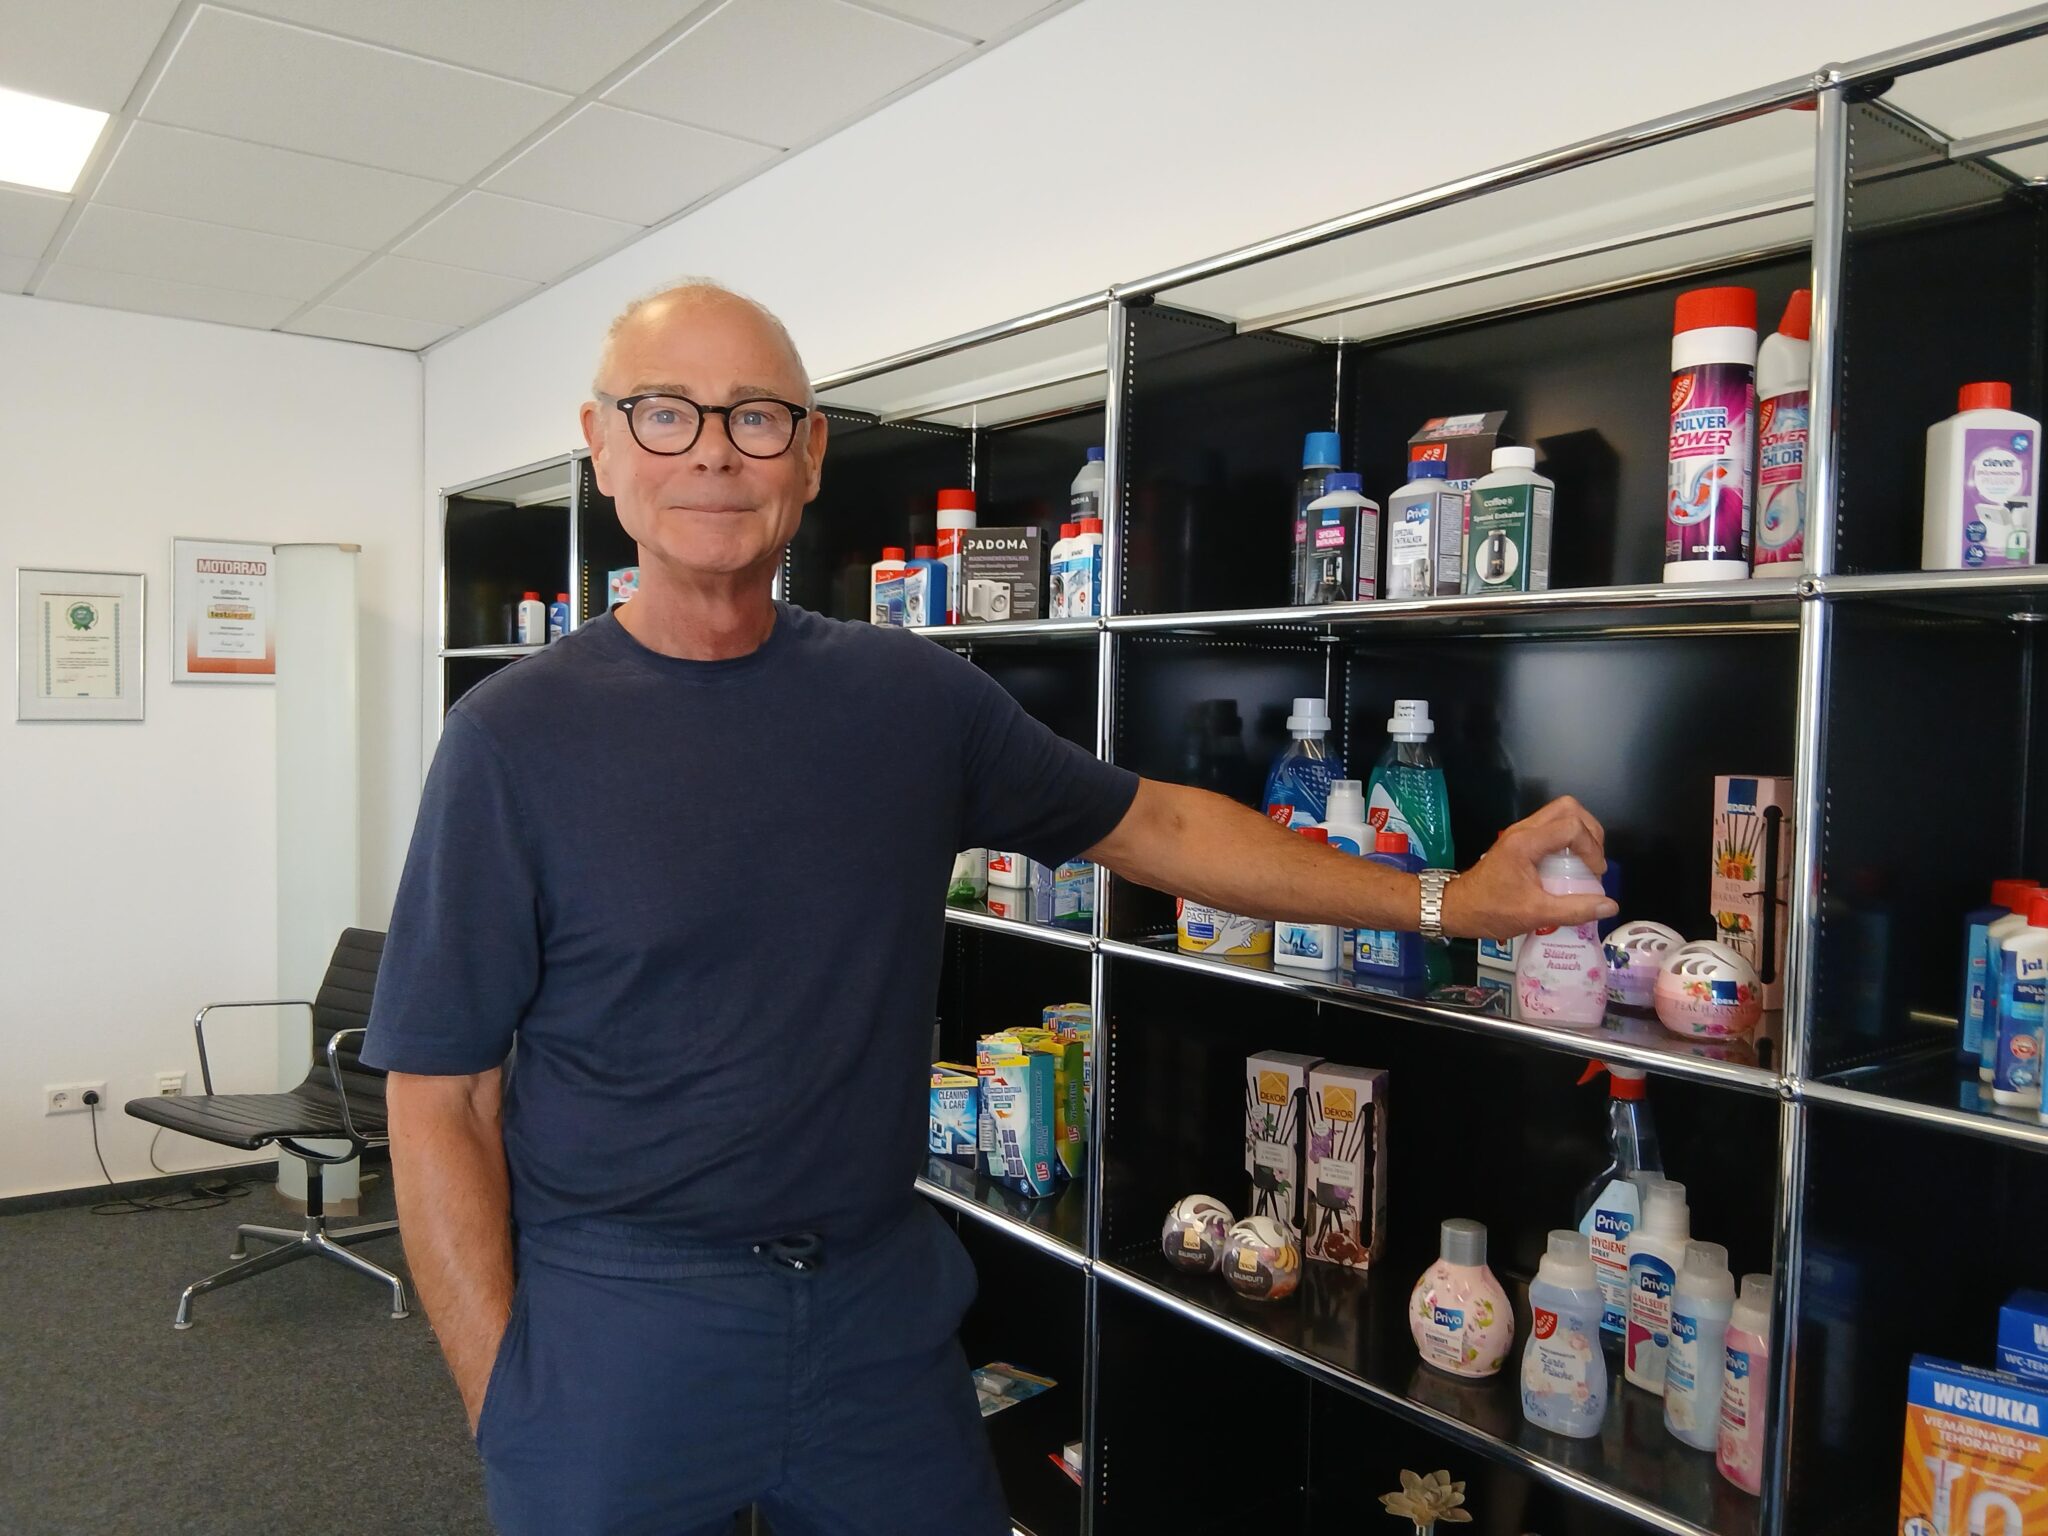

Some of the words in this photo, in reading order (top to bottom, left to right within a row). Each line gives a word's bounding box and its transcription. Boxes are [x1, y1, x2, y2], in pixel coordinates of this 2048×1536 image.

[1675, 415, 1727, 433] PULVER
[967, 539, 1029, 551] PADOMA
[1692, 544, 1727, 553] EDKA
[197, 559, 266, 576] MOTORRAD
[1186, 911, 1214, 924] PASTE
[939, 1089, 969, 1100] CLEANING
[1260, 1091, 1286, 1103] DEKOR
[949, 1099, 966, 1109] CARE
[1324, 1107, 1353, 1119] DEKOR
[1596, 1213, 1632, 1233] Priva
[1591, 1235, 1627, 1256] HYGIENE
[1641, 1276, 1670, 1293] Priva
[1434, 1309, 1463, 1326] Priva
